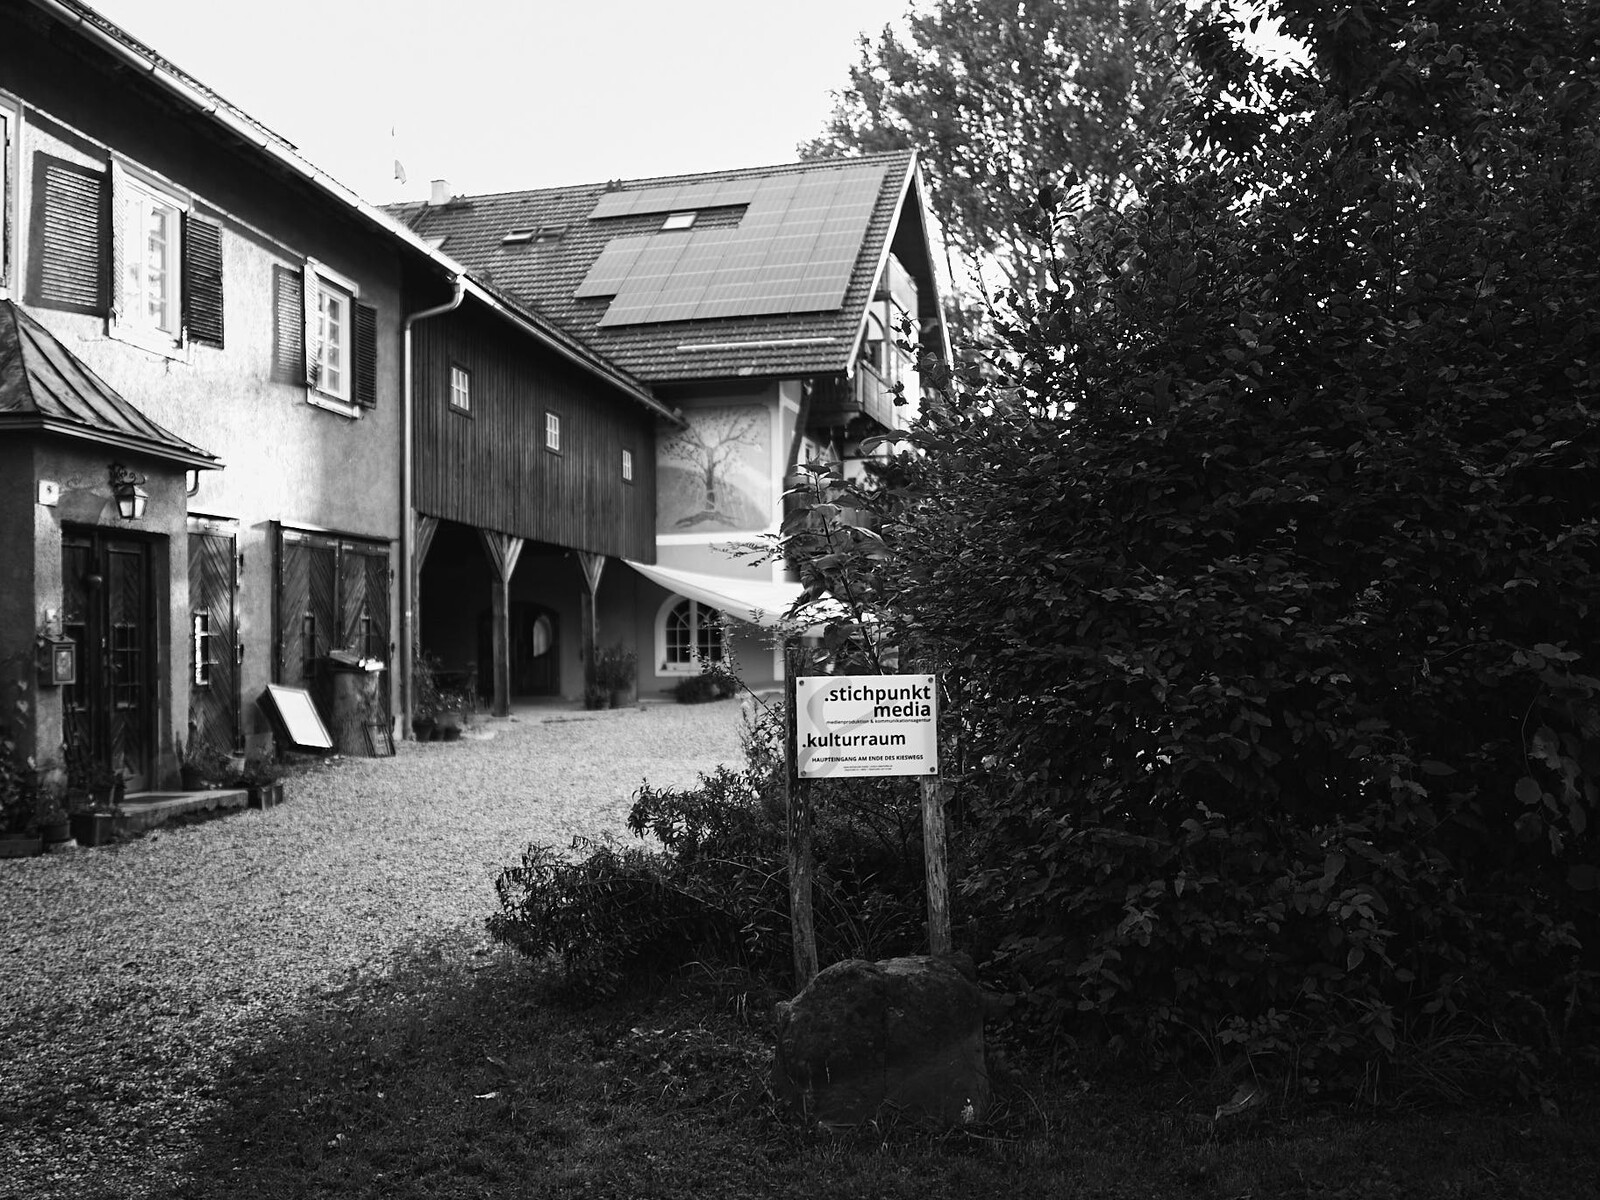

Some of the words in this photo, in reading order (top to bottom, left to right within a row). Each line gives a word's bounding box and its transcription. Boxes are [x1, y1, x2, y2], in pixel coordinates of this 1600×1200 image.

[824, 684, 931, 705] .stichpunkt
[873, 701, 931, 718] media
[802, 732, 906, 748] .kulturraum
